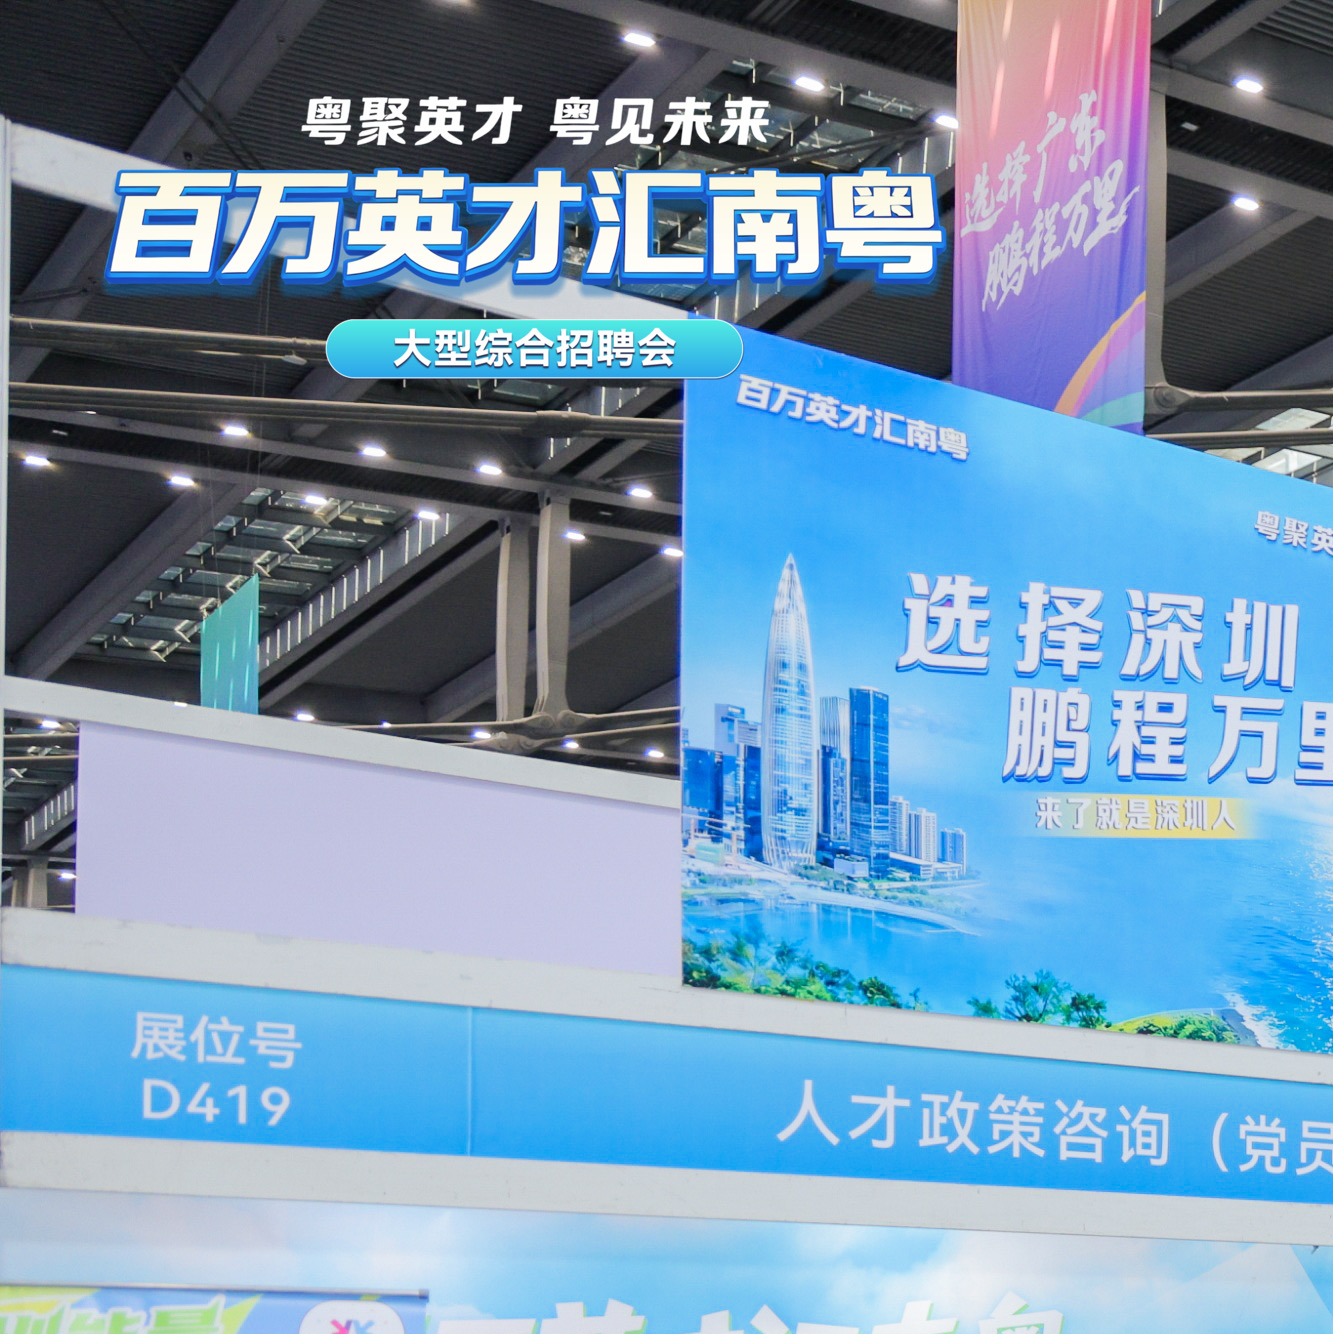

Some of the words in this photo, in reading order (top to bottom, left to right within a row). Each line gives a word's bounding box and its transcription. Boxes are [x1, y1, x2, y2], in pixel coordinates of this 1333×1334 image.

[960, 90, 1106, 237] 选择广东
[982, 159, 1140, 312] 鹏程万里
[736, 374, 969, 462] 百万英才汇南粤
[895, 572, 1301, 690] 选择深圳
[1034, 794, 1238, 834] 来了就是深圳人
[131, 1010, 302, 1069] 展位号
[142, 1078, 291, 1127] D419
